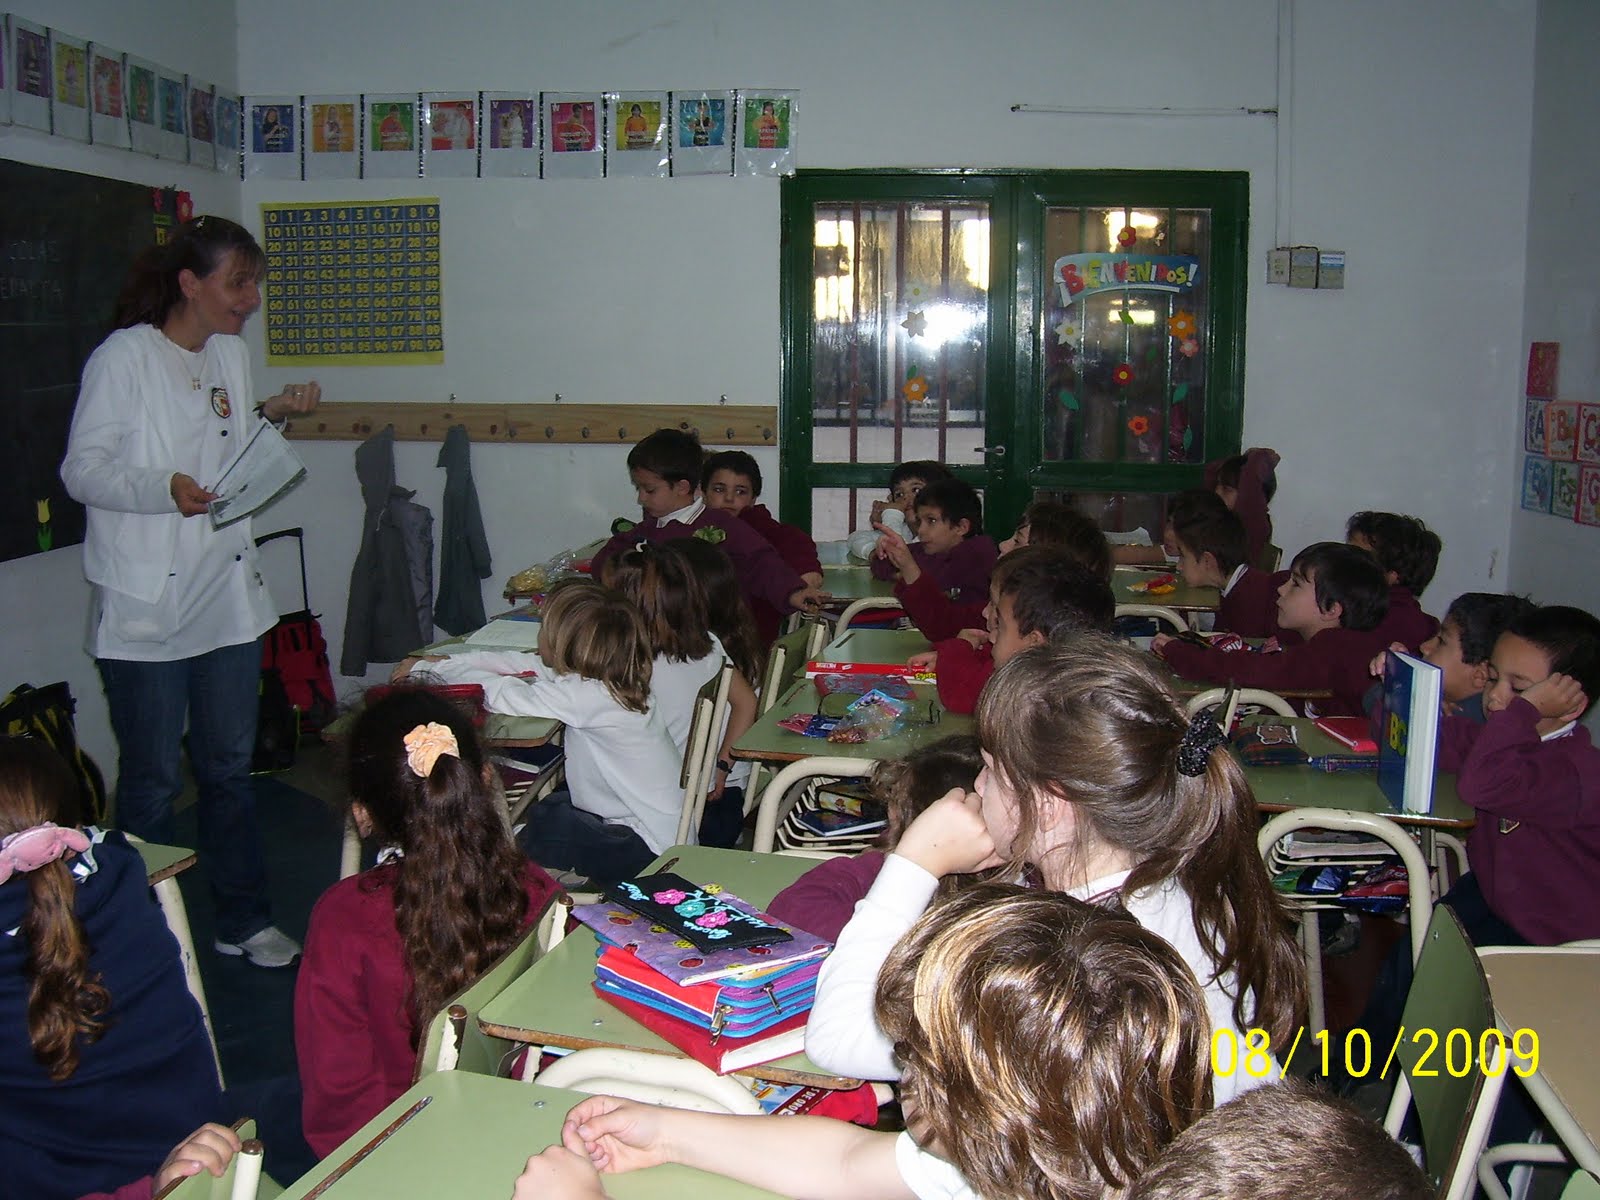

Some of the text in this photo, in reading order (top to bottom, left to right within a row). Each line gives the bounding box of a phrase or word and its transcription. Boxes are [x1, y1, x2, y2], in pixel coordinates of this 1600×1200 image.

[270, 208, 435, 222] 0 1 2 3 4 5 6 7 8 9
